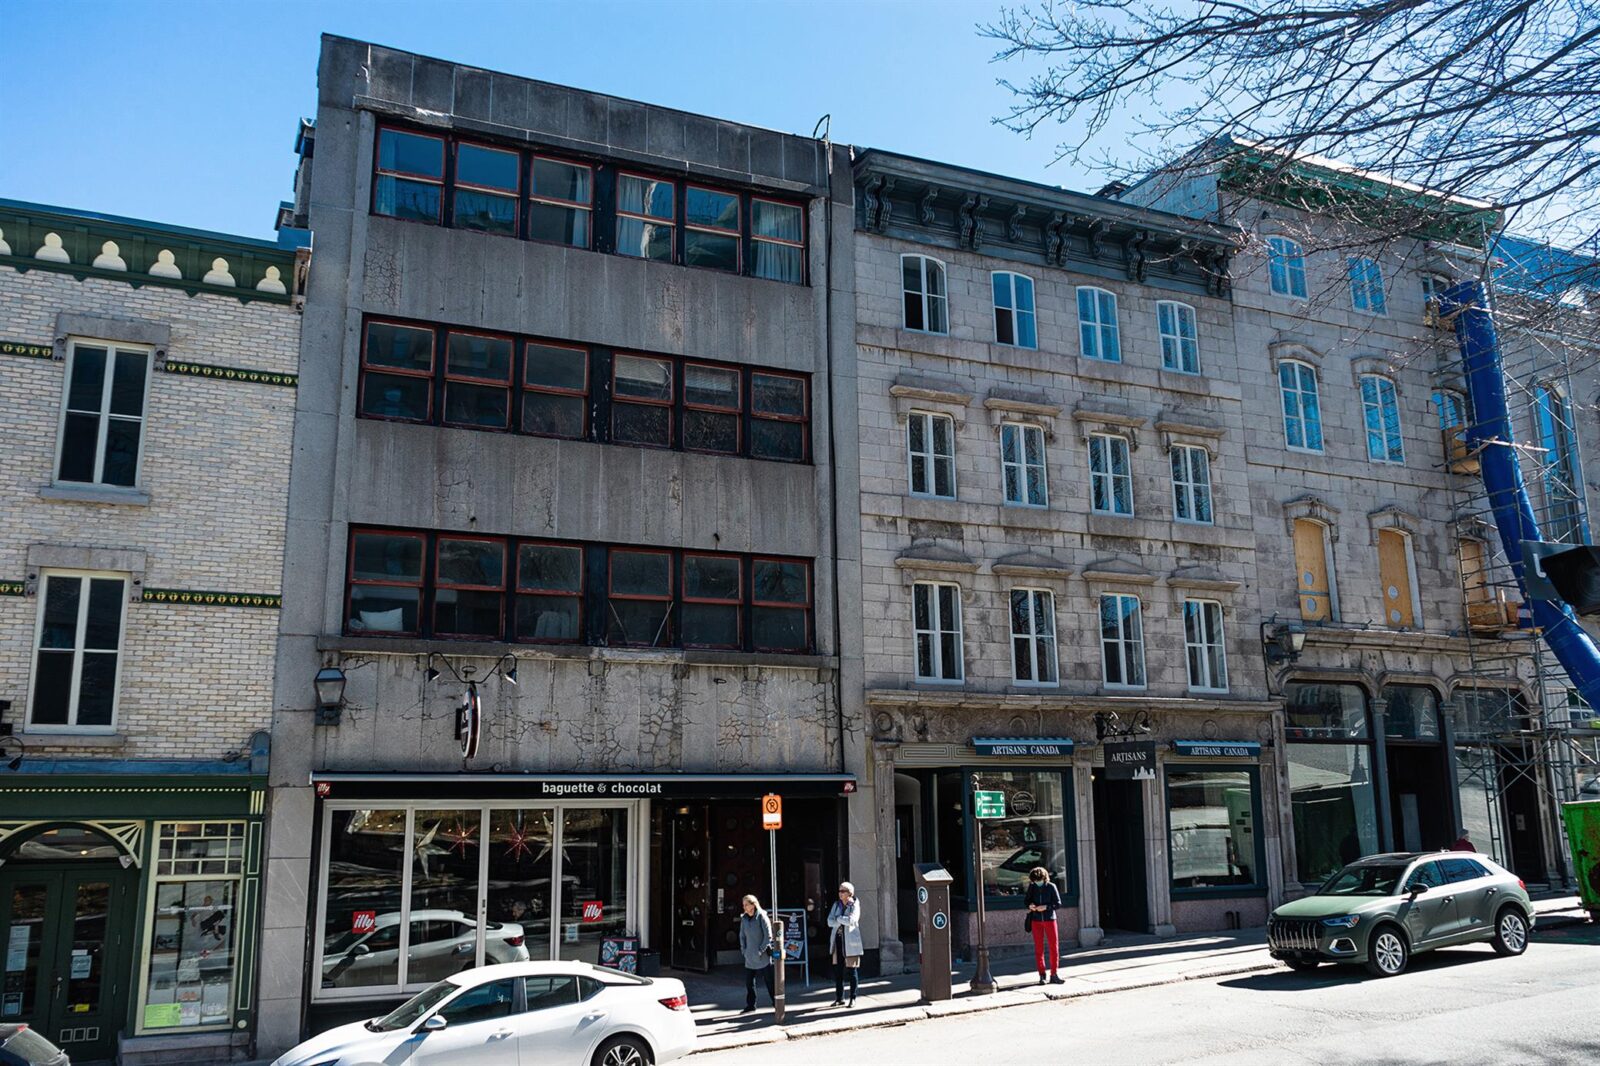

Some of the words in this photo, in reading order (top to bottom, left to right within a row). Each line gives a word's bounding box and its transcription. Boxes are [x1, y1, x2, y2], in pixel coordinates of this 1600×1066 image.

[991, 746, 1027, 755] ARTISANS
[1030, 746, 1060, 755] CANADA
[1191, 747, 1221, 756] ARTISANS
[1223, 747, 1249, 756] CANADA
[1111, 751, 1147, 763] ARTISANS
[542, 782, 594, 795] baguette
[597, 783, 606, 793] &
[611, 782, 662, 793] chocolat
[584, 904, 602, 920] illy
[353, 914, 374, 931] illy
